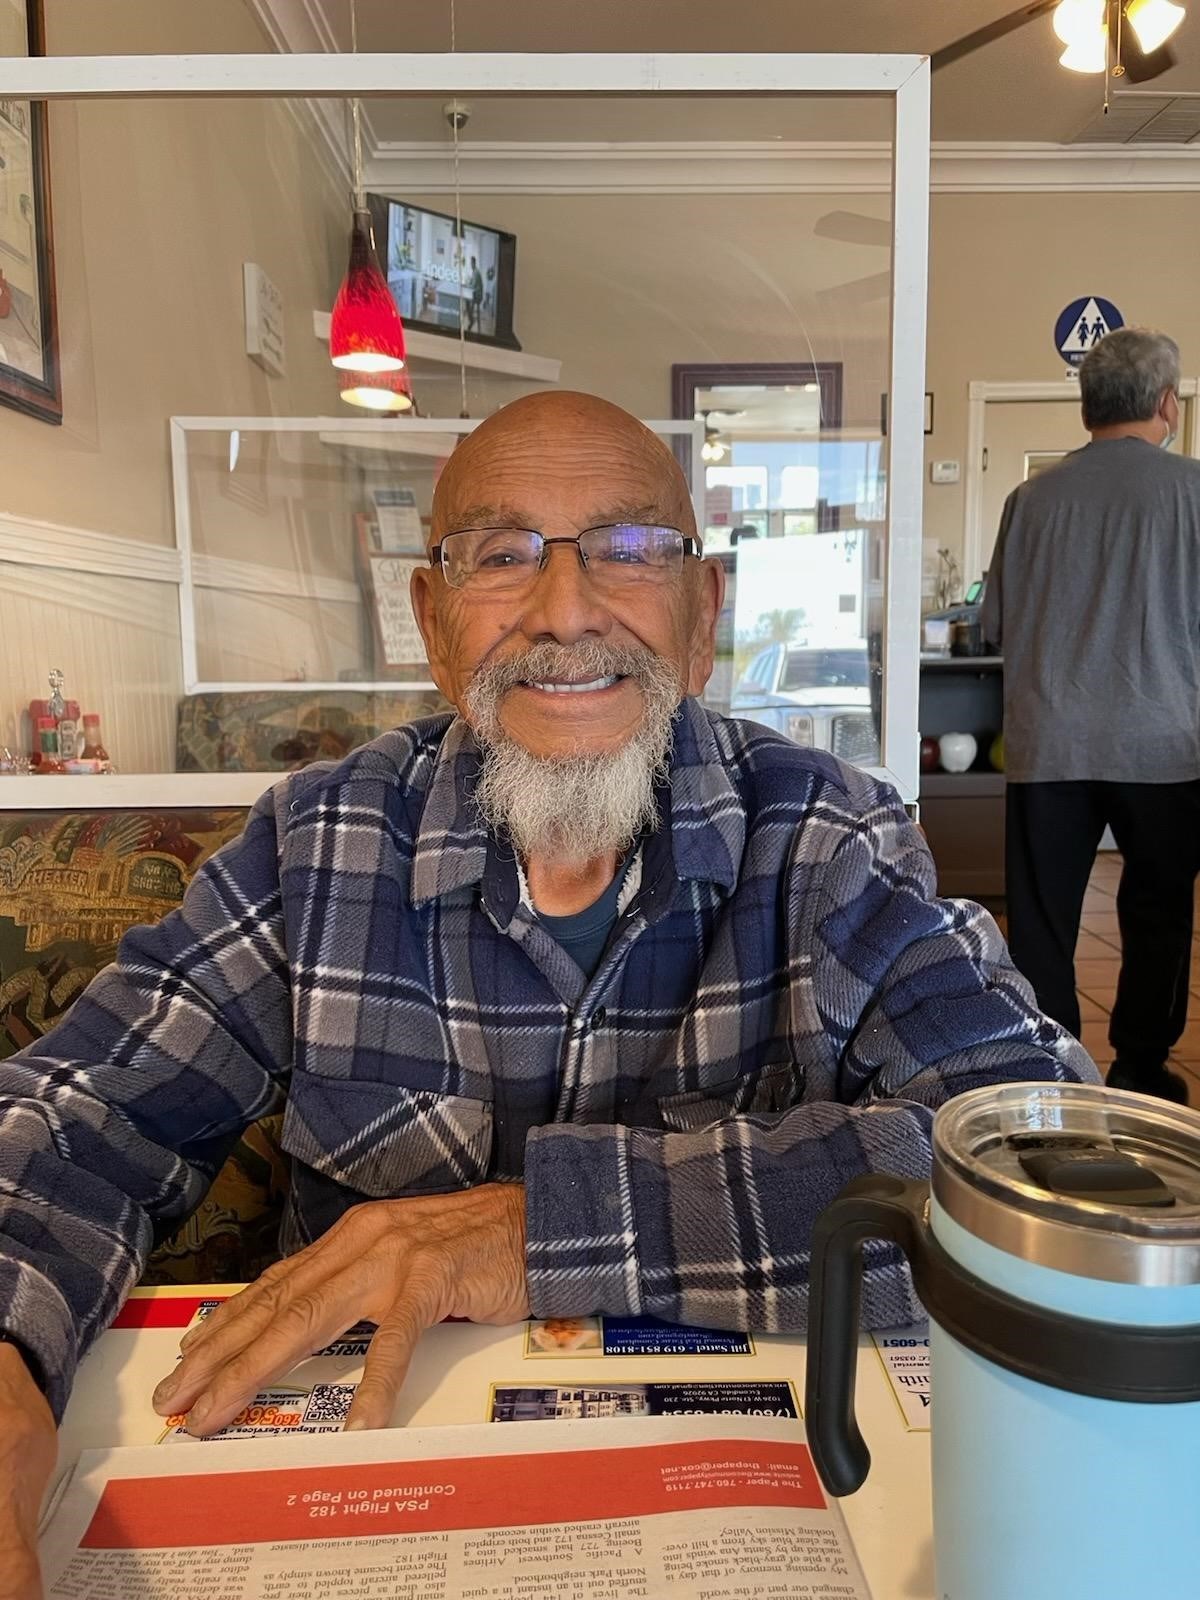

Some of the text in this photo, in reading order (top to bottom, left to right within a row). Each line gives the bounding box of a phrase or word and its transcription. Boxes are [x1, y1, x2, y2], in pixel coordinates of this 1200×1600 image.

[606, 1346, 660, 1354] 851-8108
[696, 1345, 728, 1353] Sattel
[731, 1344, 748, 1352] Jill
[274, 1413, 300, 1426] 760
[282, 1426, 316, 1434] Repair
[660, 1461, 760, 1474] thepaper@cox.net
[665, 1479, 736, 1492] 760.747.7119
[747, 1478, 778, 1487] Paper
[782, 1480, 802, 1488] The
[287, 1484, 456, 1506] Continued on Page 2
[309, 1499, 429, 1517] PSA Flight 182
[484, 1520, 640, 1539] aircraft crashed within seconds.
[754, 1528, 836, 1538] looking Mission
[354, 1538, 398, 1547] deadliest
[400, 1536, 416, 1544] the
[442, 1534, 448, 1542] It
[464, 1529, 640, 1550] small Cessna 172 and both crippled
[721, 1538, 745, 1546] from
[750, 1536, 766, 1545] sky
[770, 1537, 792, 1546] blue
[794, 1538, 819, 1546] clear
[823, 1538, 838, 1546] the
[270, 1543, 309, 1552] disaster
[312, 1540, 352, 1550] aviation
[580, 1542, 598, 1550] 727
[604, 1538, 642, 1548] Boeing
[661, 1542, 688, 1552] over-
[692, 1540, 709, 1550] hill
[503, 1546, 548, 1556] smacked
[554, 1544, 573, 1552] had
[720, 1547, 740, 1556] Ana
[743, 1546, 772, 1554] Santa
[776, 1544, 788, 1555] by
[791, 1545, 803, 1553] up
[418, 1552, 448, 1562] Flight
[463, 1548, 643, 1567] A Pacific Southwest Airlines
[476, 1549, 496, 1557] into
[662, 1553, 682, 1562] into
[686, 1550, 716, 1560] winds
[222, 1556, 252, 1564] dump
[695, 1558, 729, 1569] smoke
[732, 1554, 786, 1566] gray-black
[788, 1556, 800, 1564] of
[802, 1555, 822, 1564] pile
[220, 1566, 250, 1574] editor
[354, 1566, 393, 1574] became
[396, 1563, 424, 1572] event
[426, 1562, 446, 1570] The
[664, 1562, 692, 1572] being
[278, 1570, 312, 1580] simply
[316, 1568, 350, 1577] known
[404, 1569, 446, 1582] pellered
[512, 1568, 646, 1584] North Park neighborhood.
[665, 1562, 848, 1582] My opening memory of that day is
[155, 1576, 186, 1586] really
[191, 1576, 220, 1585] really
[314, 1578, 353, 1590] toppled
[360, 1575, 398, 1586] aircraft
[588, 1580, 604, 1588] out
[608, 1578, 647, 1588] snuffed
[172, 1585, 220, 1594] definitely
[377, 1586, 388, 1594] as
[394, 1584, 418, 1594] died
[424, 1582, 446, 1591] also
[517, 1584, 552, 1594] instant
[556, 1582, 568, 1590] an
[572, 1582, 583, 1590] in
[768, 1584, 788, 1593] part
[812, 1584, 854, 1594] changed
[318, 1590, 330, 1598] of
[337, 1586, 369, 1596] pieces
[462, 1588, 488, 1598] quiet
[502, 1587, 512, 1595] in
[592, 1590, 618, 1599] lives
[627, 1587, 648, 1596] The
[696, 1589, 730, 1600] world.
[734, 1588, 750, 1596] the
[752, 1587, 764, 1596] of
[287, 1592, 312, 1600] their
[572, 1592, 583, 1600] of
